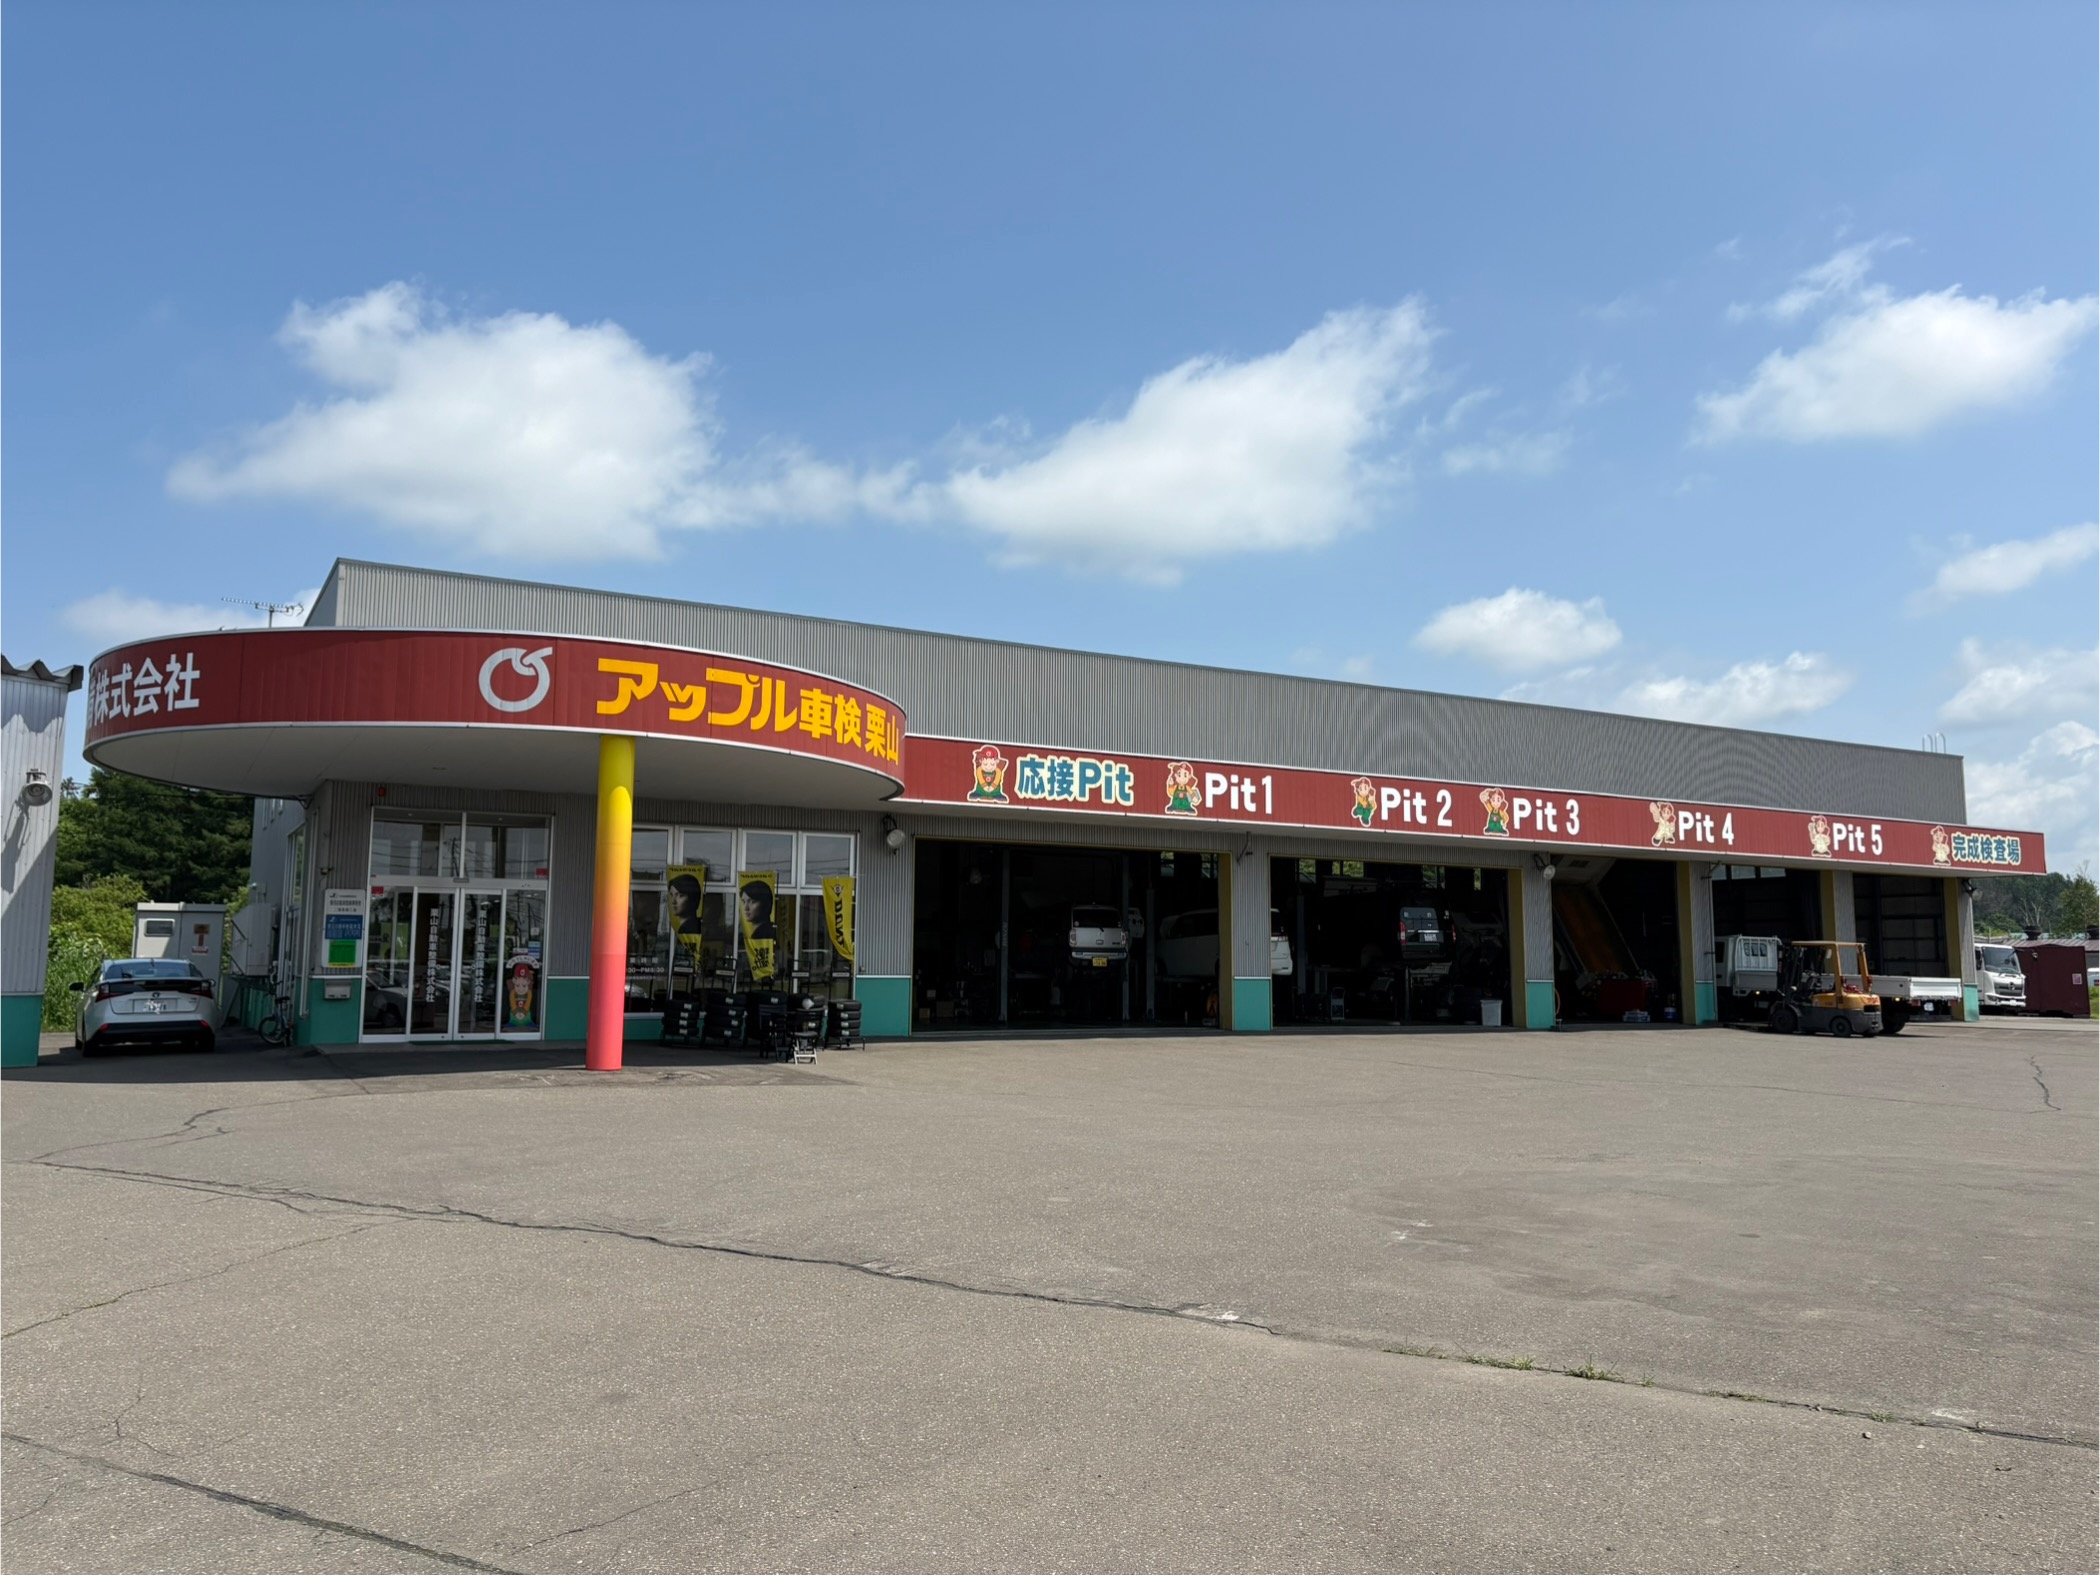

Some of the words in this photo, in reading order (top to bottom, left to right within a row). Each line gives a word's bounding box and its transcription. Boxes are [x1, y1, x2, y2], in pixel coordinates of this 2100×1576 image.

[597, 657, 900, 765] アップル車検栗山
[1017, 757, 1133, 803] 応接Pit
[1380, 786, 1428, 825] Pit
[1436, 788, 1453, 827] 2
[1512, 797, 1558, 833] Pit
[1565, 798, 1580, 836] 3
[1678, 810, 1715, 844] Pit
[1721, 812, 1735, 846] 4
[1832, 822, 1866, 854] Pit
[1871, 823, 1883, 856] 5
[1952, 834, 2020, 863] 完成検査場
